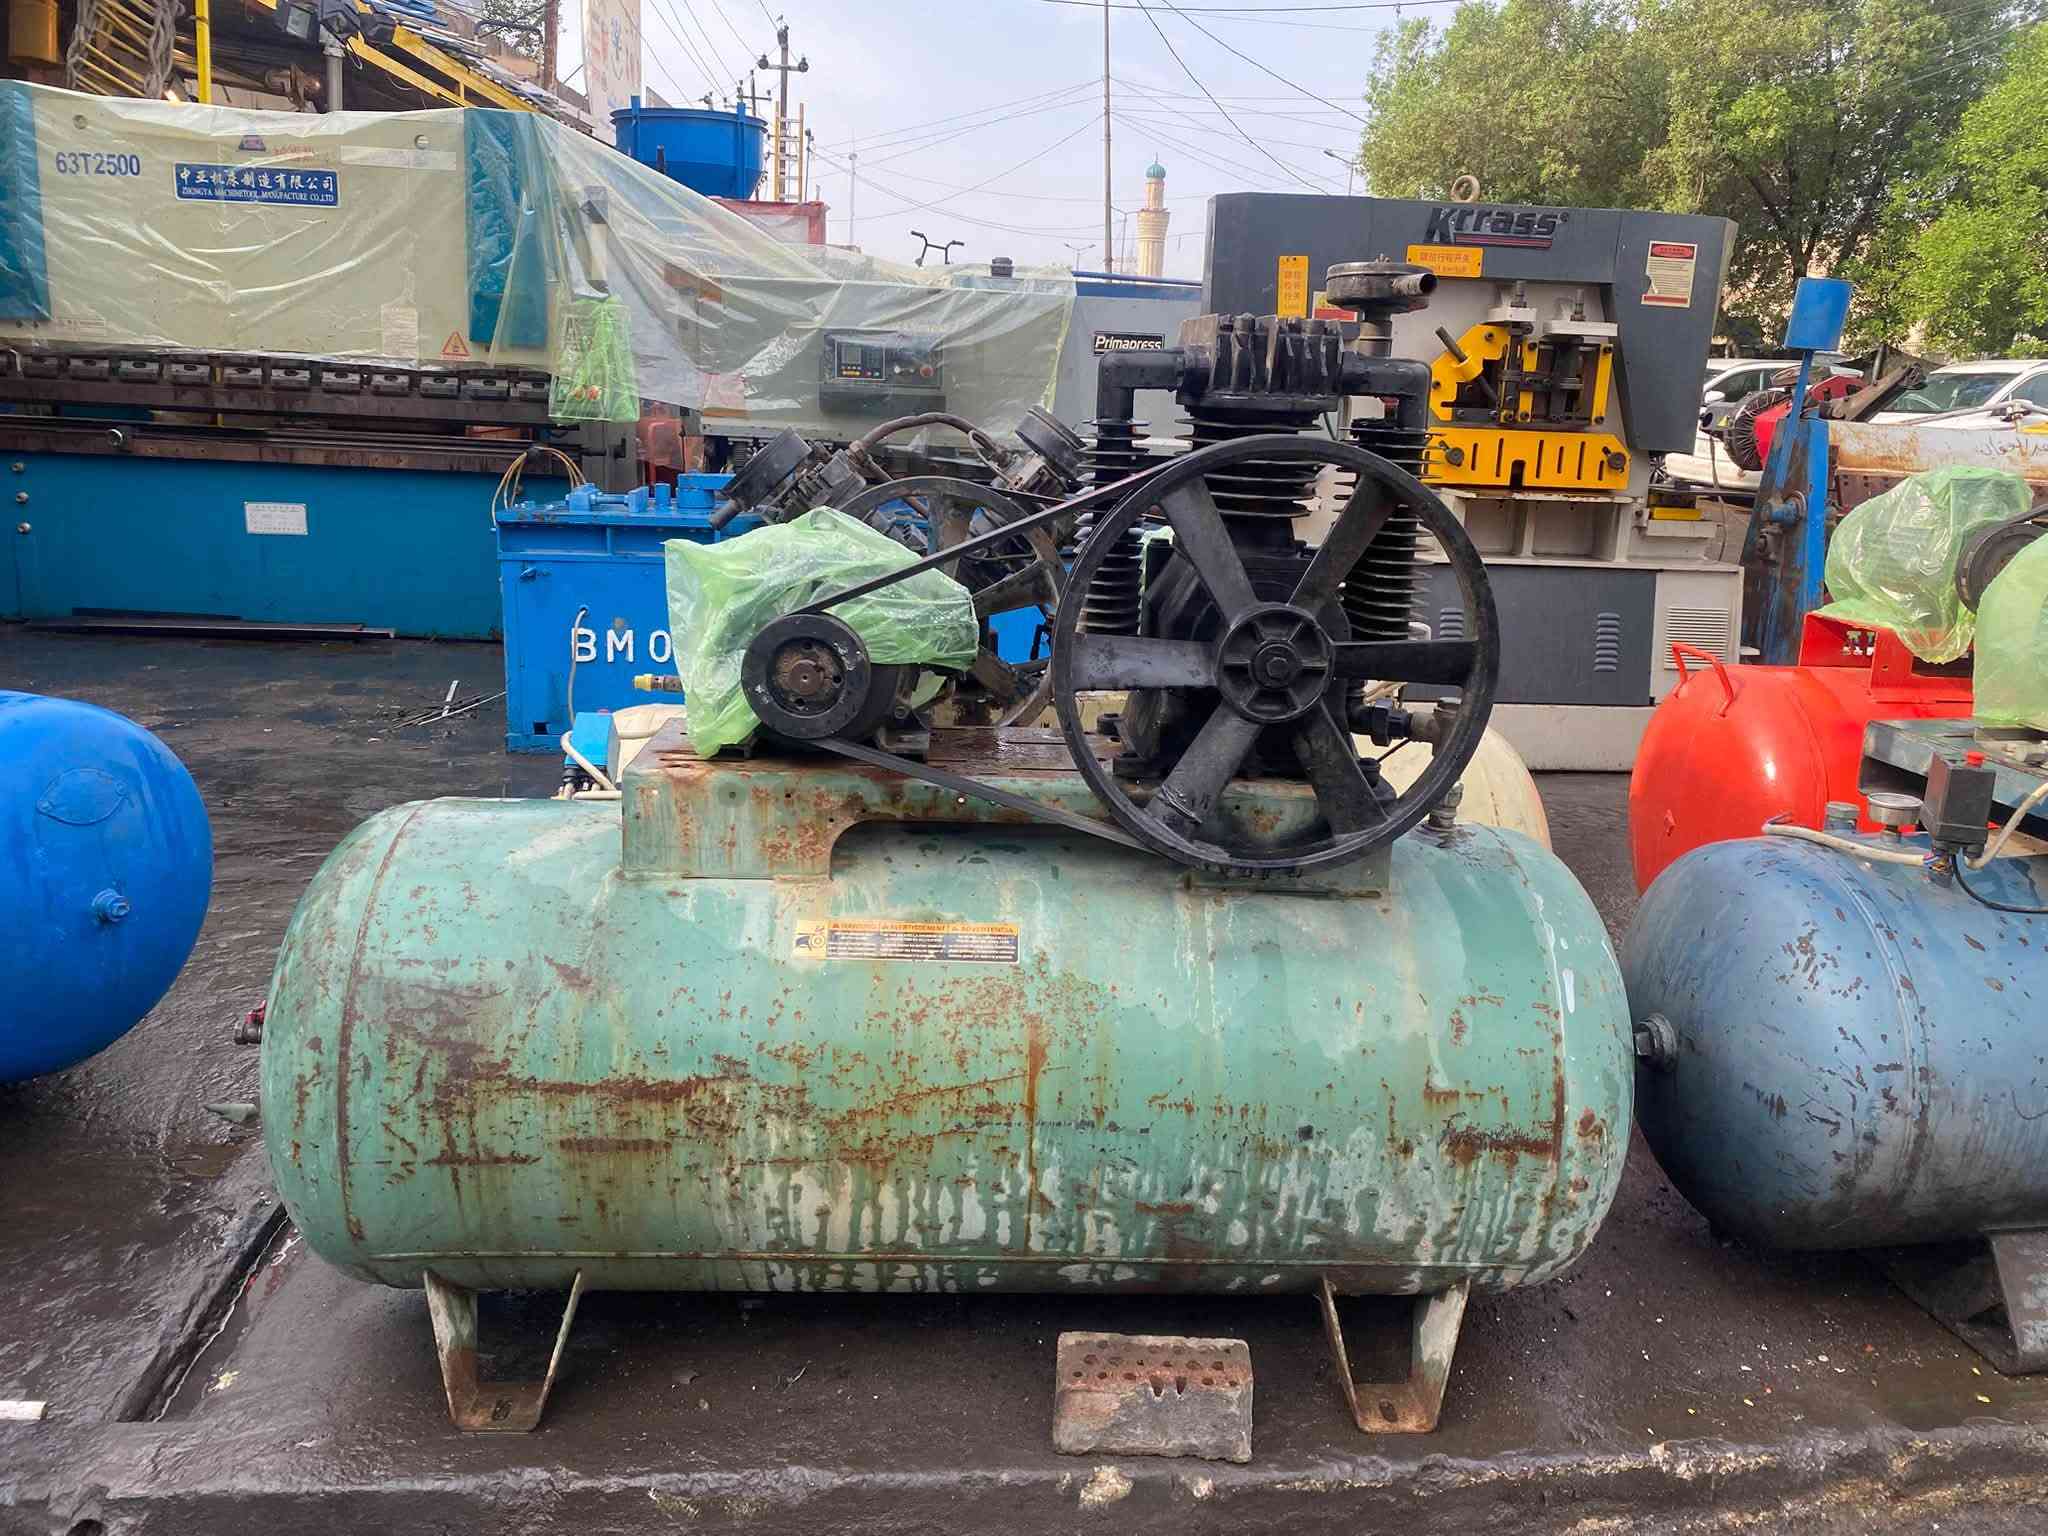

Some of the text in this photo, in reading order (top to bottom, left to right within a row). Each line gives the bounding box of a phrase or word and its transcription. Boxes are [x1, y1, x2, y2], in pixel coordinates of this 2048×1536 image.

[56, 151, 141, 176] 63T2500
[261, 191, 308, 201] MANUFACTURE
[1095, 335, 1162, 351] Primapress
